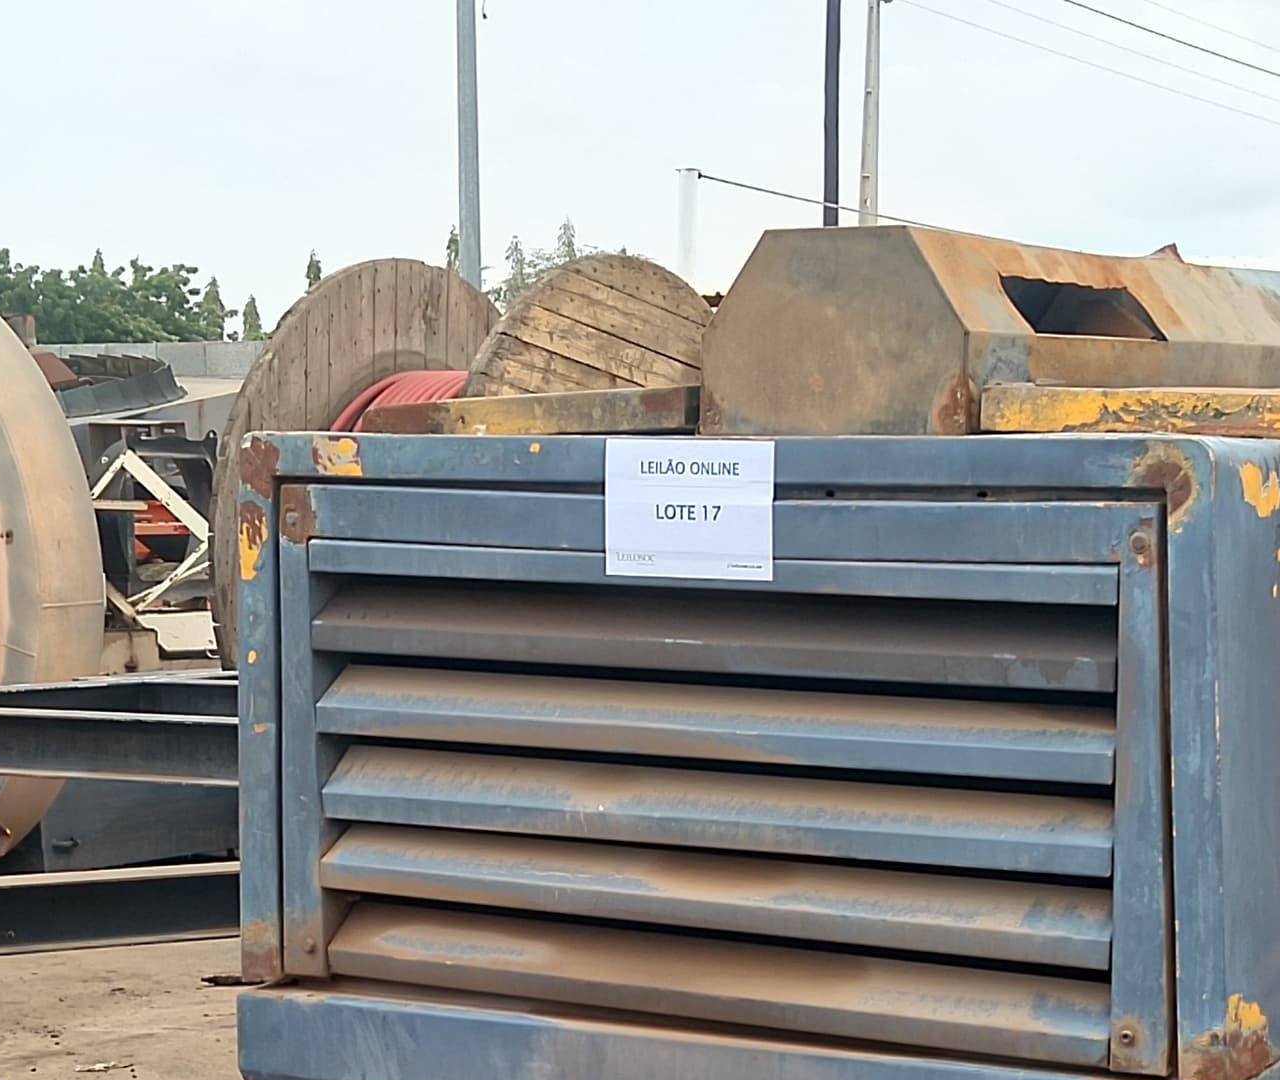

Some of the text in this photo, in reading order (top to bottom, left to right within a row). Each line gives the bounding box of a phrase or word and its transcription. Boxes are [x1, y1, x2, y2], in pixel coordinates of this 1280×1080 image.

[640, 459, 740, 476] LEILÃO ONLINE
[656, 504, 721, 521] LOTE 17
